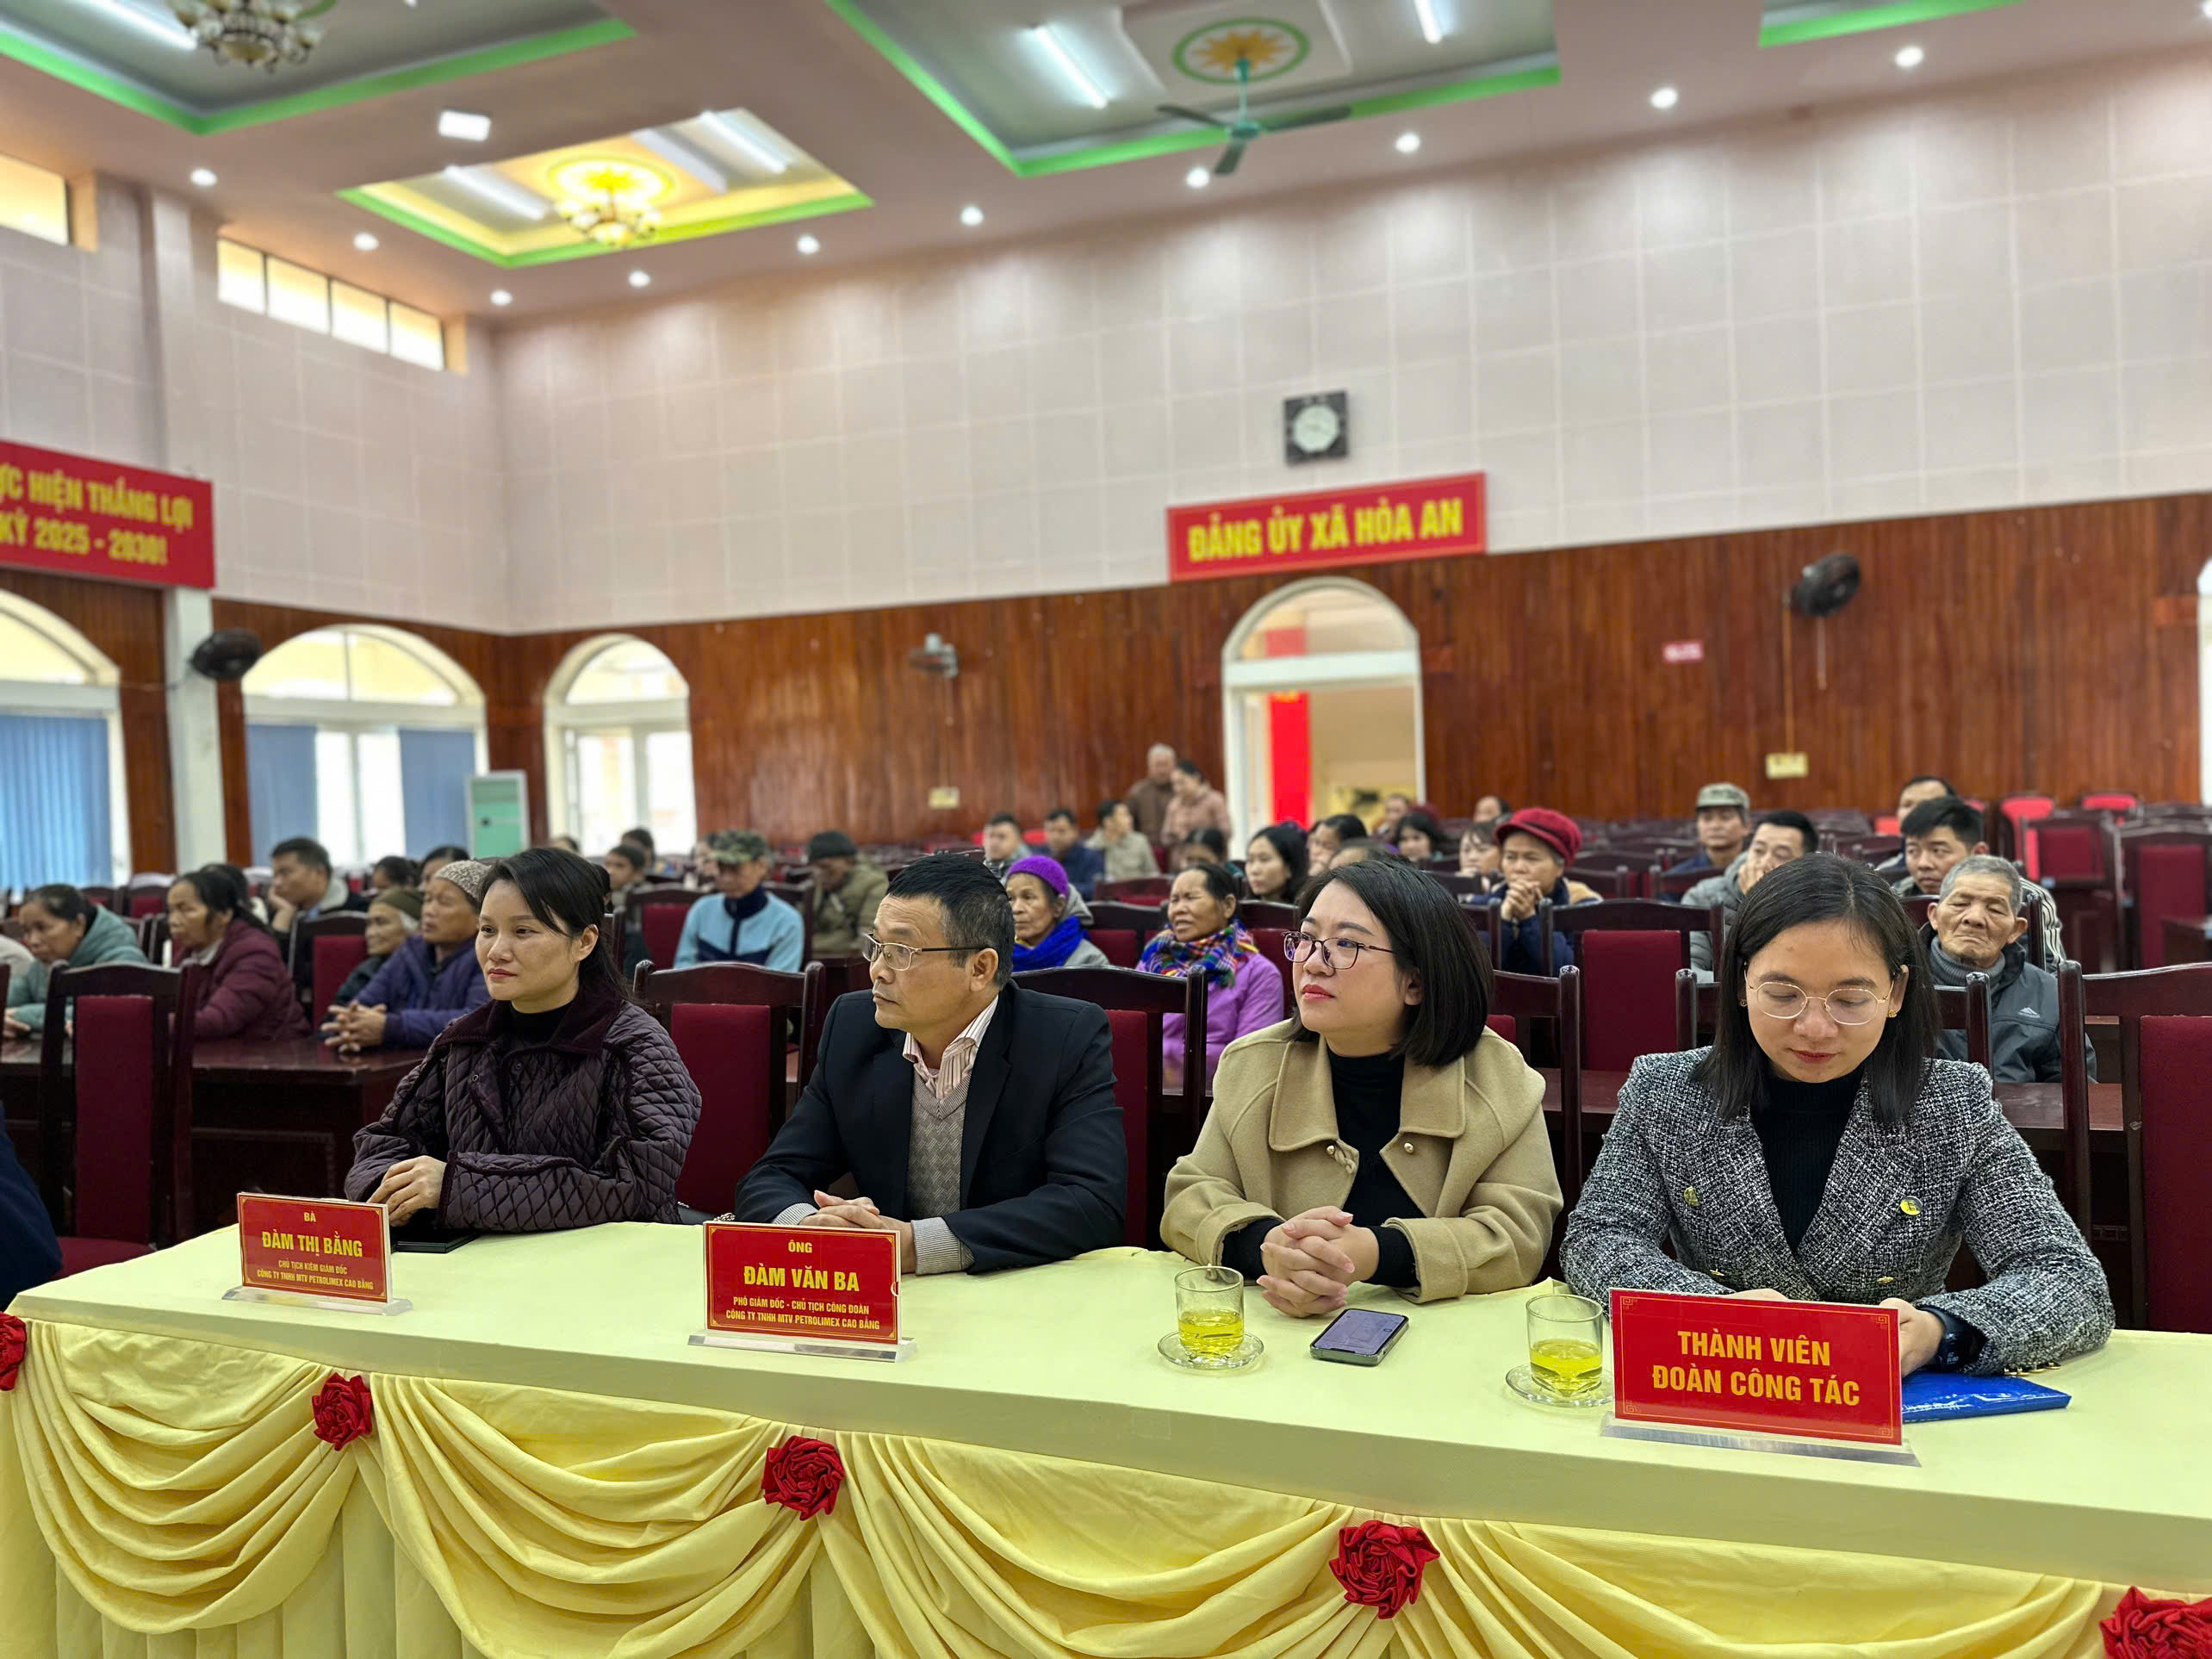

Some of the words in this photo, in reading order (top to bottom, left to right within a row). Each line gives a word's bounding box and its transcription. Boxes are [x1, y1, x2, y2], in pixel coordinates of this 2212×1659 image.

[34, 518, 90, 556] 2025
[109, 528, 168, 566] 2030
[1188, 513, 1263, 562] ĐẢNG
[1268, 505, 1303, 554] ỦY
[1310, 504, 1350, 550] XÃ
[1355, 497, 1414, 544] HÒA
[1420, 498, 1463, 537] AN
[303, 1210, 316, 1222] BÀ
[262, 1229, 294, 1250] ĐÀM
[297, 1235, 320, 1257] THỊ
[324, 1230, 363, 1258] BẰNG
[788, 1240, 812, 1253] ÔNG
[257, 1268, 272, 1278] CÔNG
[273, 1271, 280, 1279] TY
[281, 1271, 295, 1281] TNHH
[295, 1273, 308, 1283] MTV
[309, 1275, 343, 1287] PETROLIMEX
[345, 1279, 356, 1288] CAO
[357, 1277, 374, 1289] BẰNG
[278, 1258, 289, 1269] CHỦ
[291, 1260, 303, 1271] TỊCH
[320, 1263, 334, 1274] GIÁM
[335, 1263, 348, 1275] ĐỐC
[743, 1263, 786, 1287] ĐÀM
[791, 1265, 828, 1290] VĂN
[834, 1271, 860, 1292] BA
[733, 1296, 748, 1306] PHÓ
[749, 1296, 768, 1308] GIÁM
[770, 1296, 785, 1309] ĐỐC
[792, 1297, 806, 1311] CHỦ
[808, 1302, 824, 1314] TỊCH
[826, 1302, 847, 1314] CÔNG
[848, 1303, 869, 1314] ĐOÀN
[726, 1308, 746, 1320] CÔNG
[747, 1312, 756, 1320] TY
[757, 1313, 776, 1322] TNHH
[778, 1314, 793, 1324] MTV
[795, 1315, 840, 1327] PETROLIMEX
[842, 1318, 857, 1328] CAO
[859, 1315, 879, 1330] BẰNG
[1677, 1327, 1762, 1360] THÀNH
[1770, 1334, 1831, 1366] VIÊN
[1652, 1363, 1722, 1394] ĐOÀN
[1730, 1368, 1802, 1401] CÔNG
[1809, 1374, 1861, 1406] TÁC
